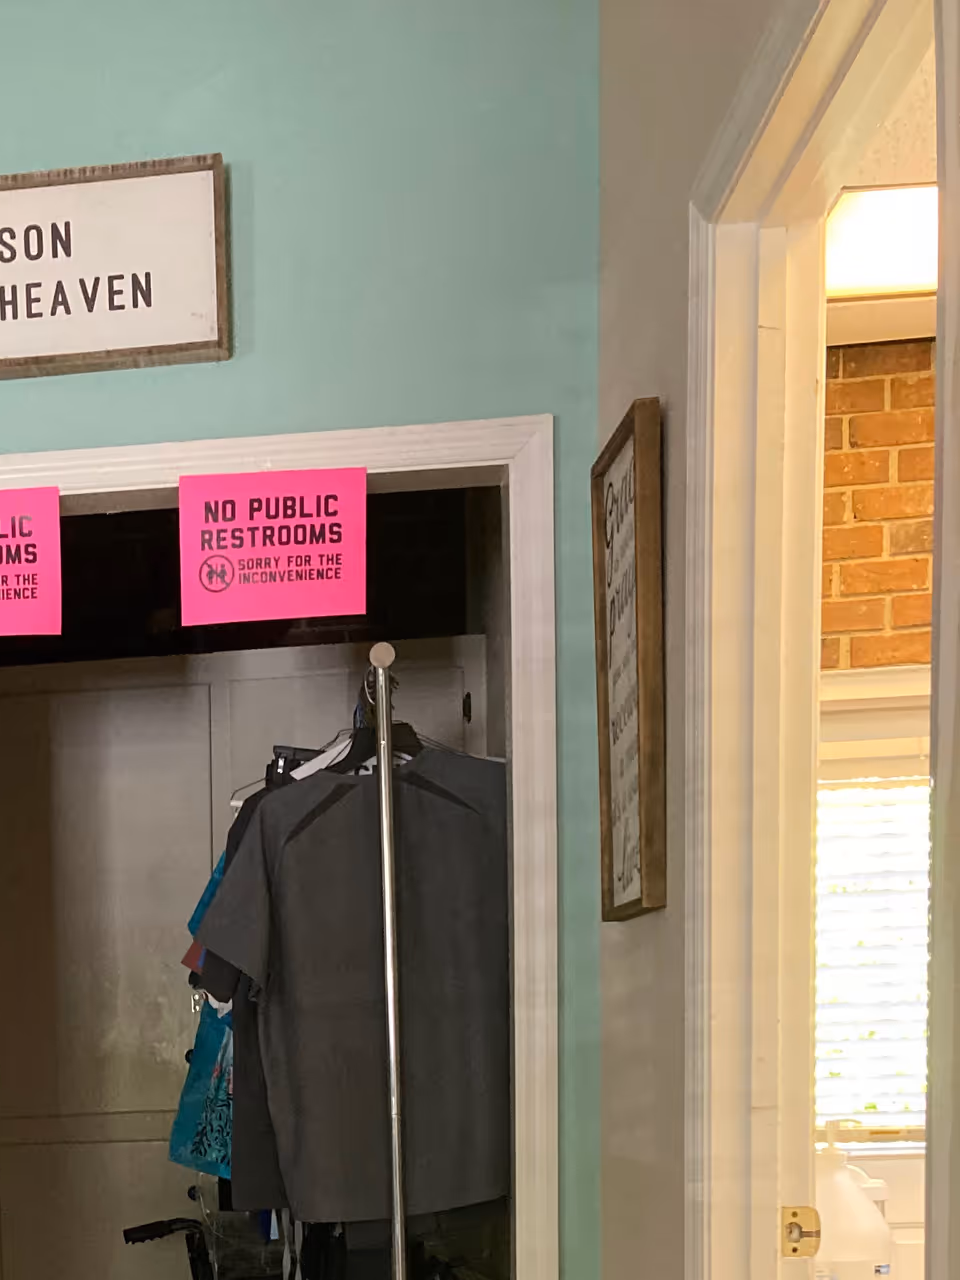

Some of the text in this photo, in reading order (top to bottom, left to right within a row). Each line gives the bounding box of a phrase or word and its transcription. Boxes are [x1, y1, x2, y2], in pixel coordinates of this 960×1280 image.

[204, 494, 339, 524] NO PUBLIC
[200, 522, 343, 551] RESTROOMS
[238, 553, 343, 571] SORRY FOR THE
[15, 573, 38, 586] THE
[238, 567, 342, 584] INCONVENIENCE
